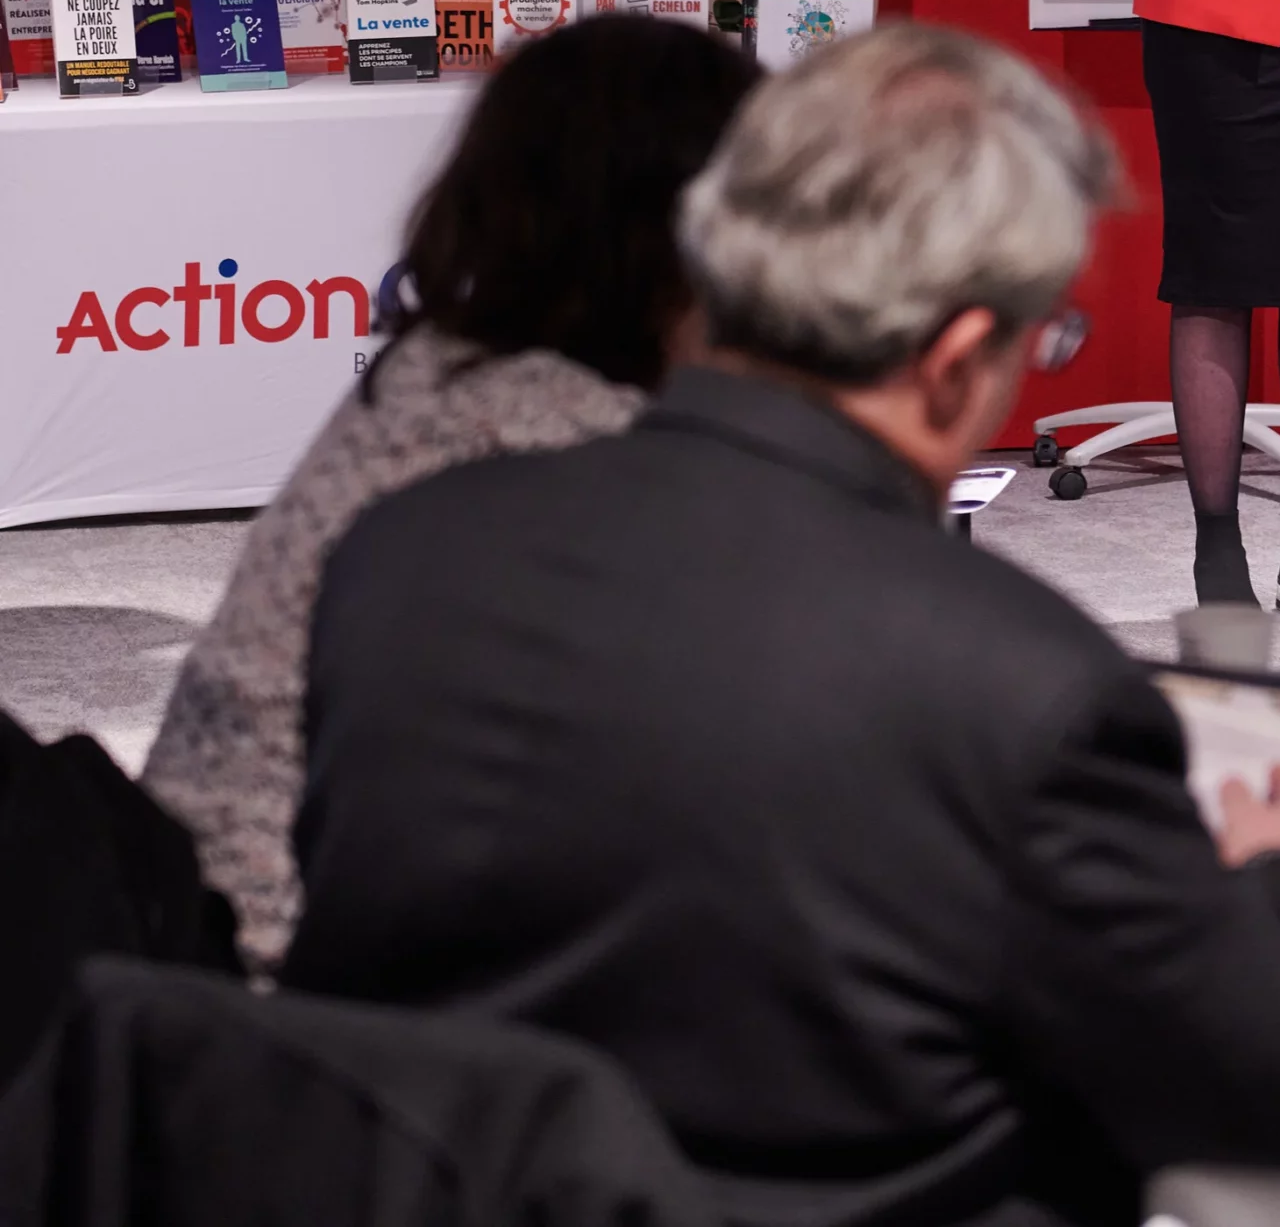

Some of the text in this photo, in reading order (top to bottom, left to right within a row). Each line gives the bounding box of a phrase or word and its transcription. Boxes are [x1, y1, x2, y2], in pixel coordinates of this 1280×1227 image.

[10, 8, 51, 19] RÉALISEN
[77, 11, 113, 26] JAMAIS
[524, 14, 554, 22] vendre
[11, 25, 53, 35] ENTREPRE
[357, 16, 430, 30] La vente
[74, 26, 118, 41] LA POIRE
[76, 41, 118, 56] EN DEUX
